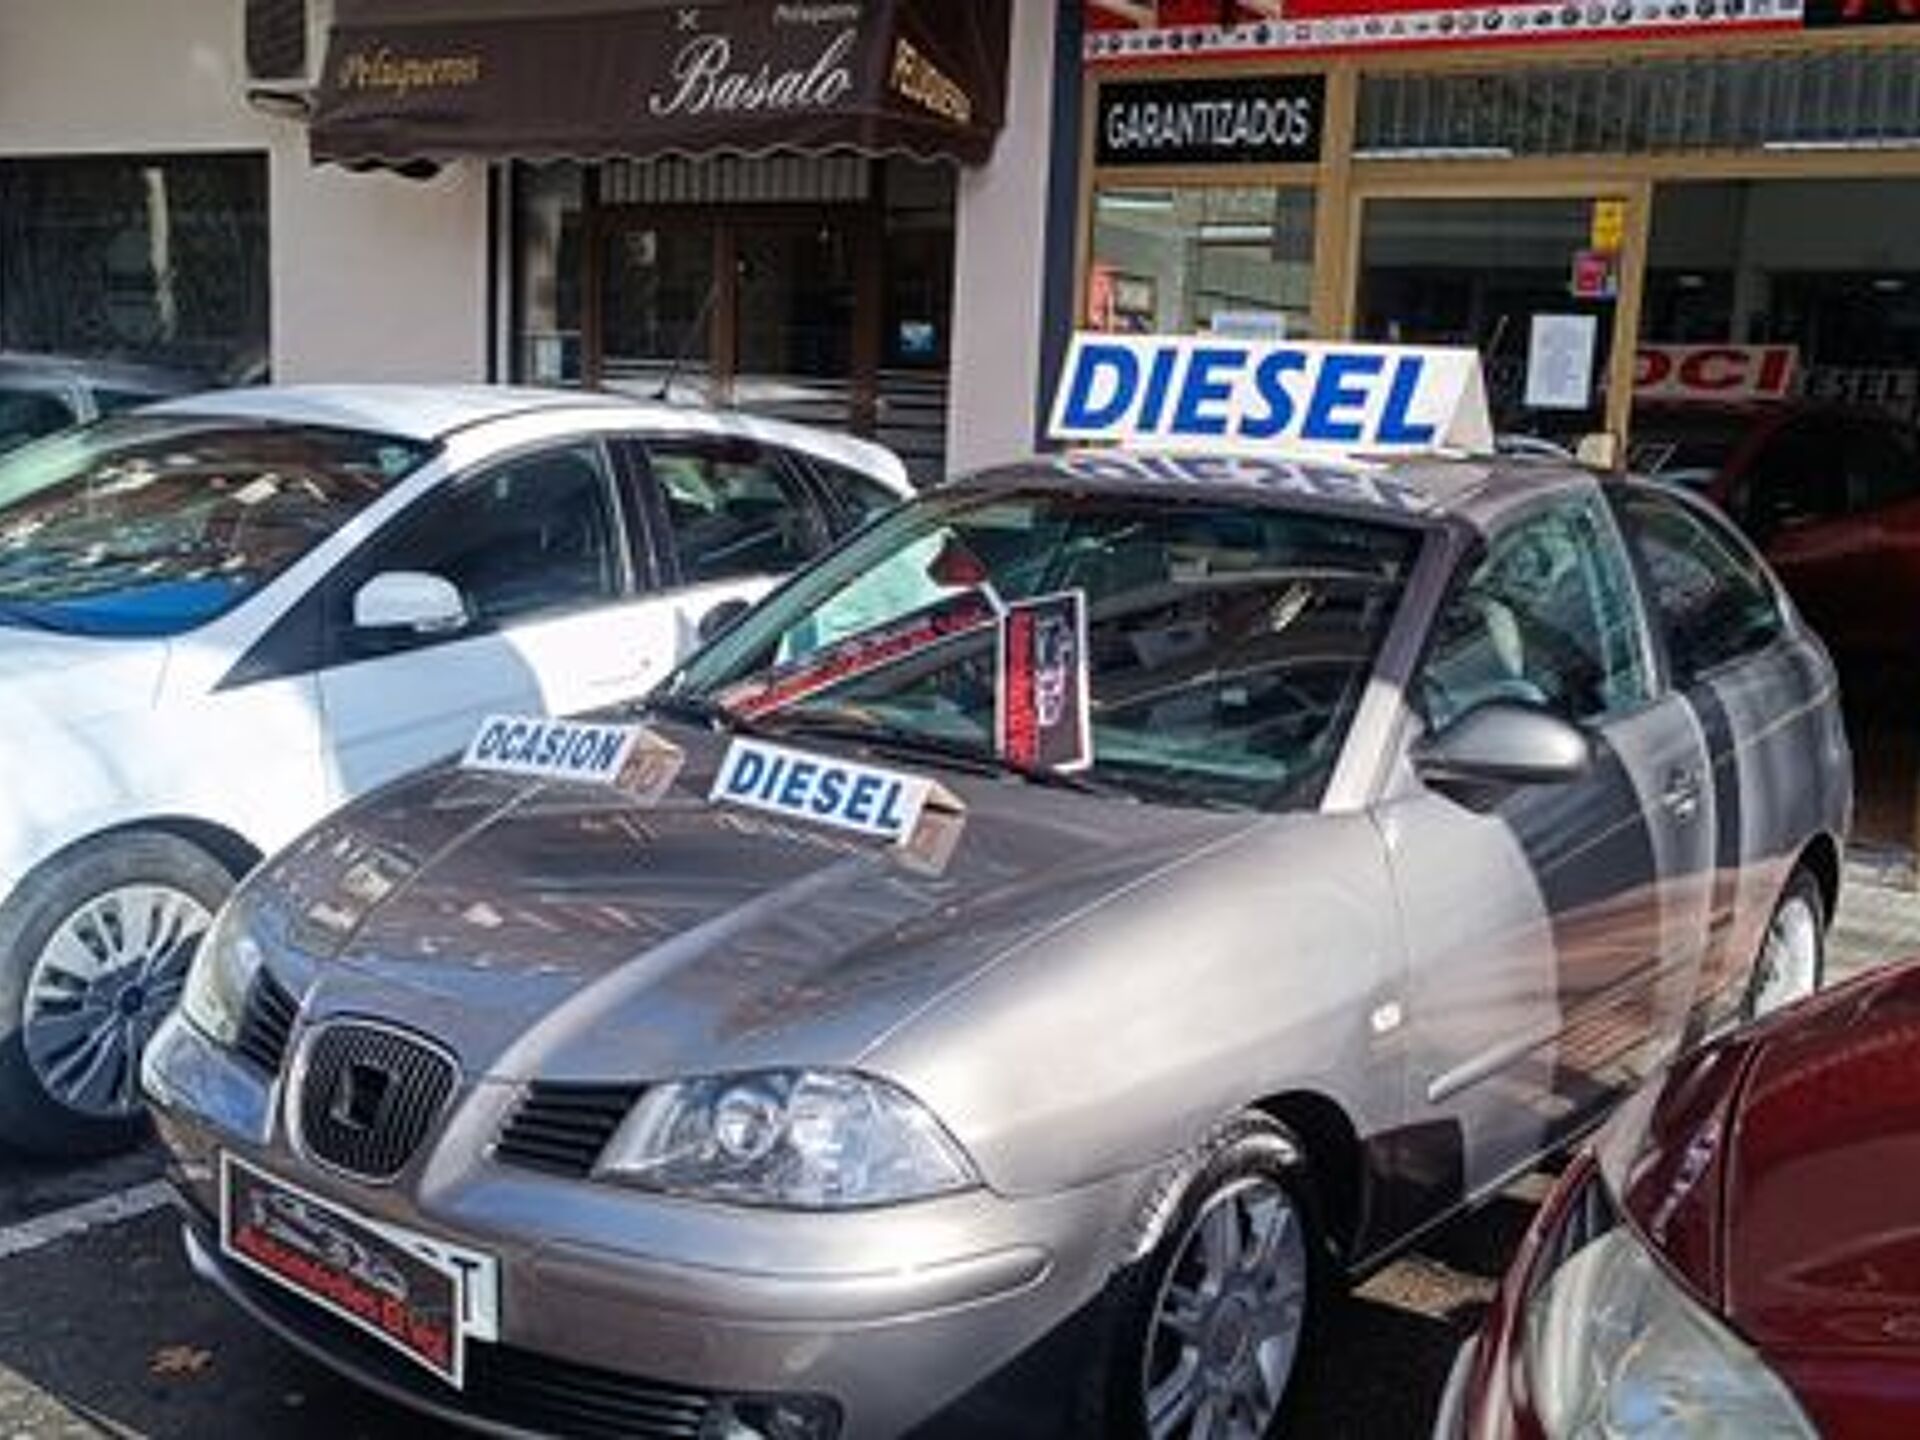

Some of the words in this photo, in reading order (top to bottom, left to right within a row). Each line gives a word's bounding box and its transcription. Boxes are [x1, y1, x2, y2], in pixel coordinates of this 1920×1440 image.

[650, 28, 856, 114] Basalo
[1107, 98, 1310, 149] GARANTIZADOS
[1061, 343, 1435, 444] DIESEL
[476, 722, 626, 771] OCASION
[729, 750, 904, 829] DIESEL
